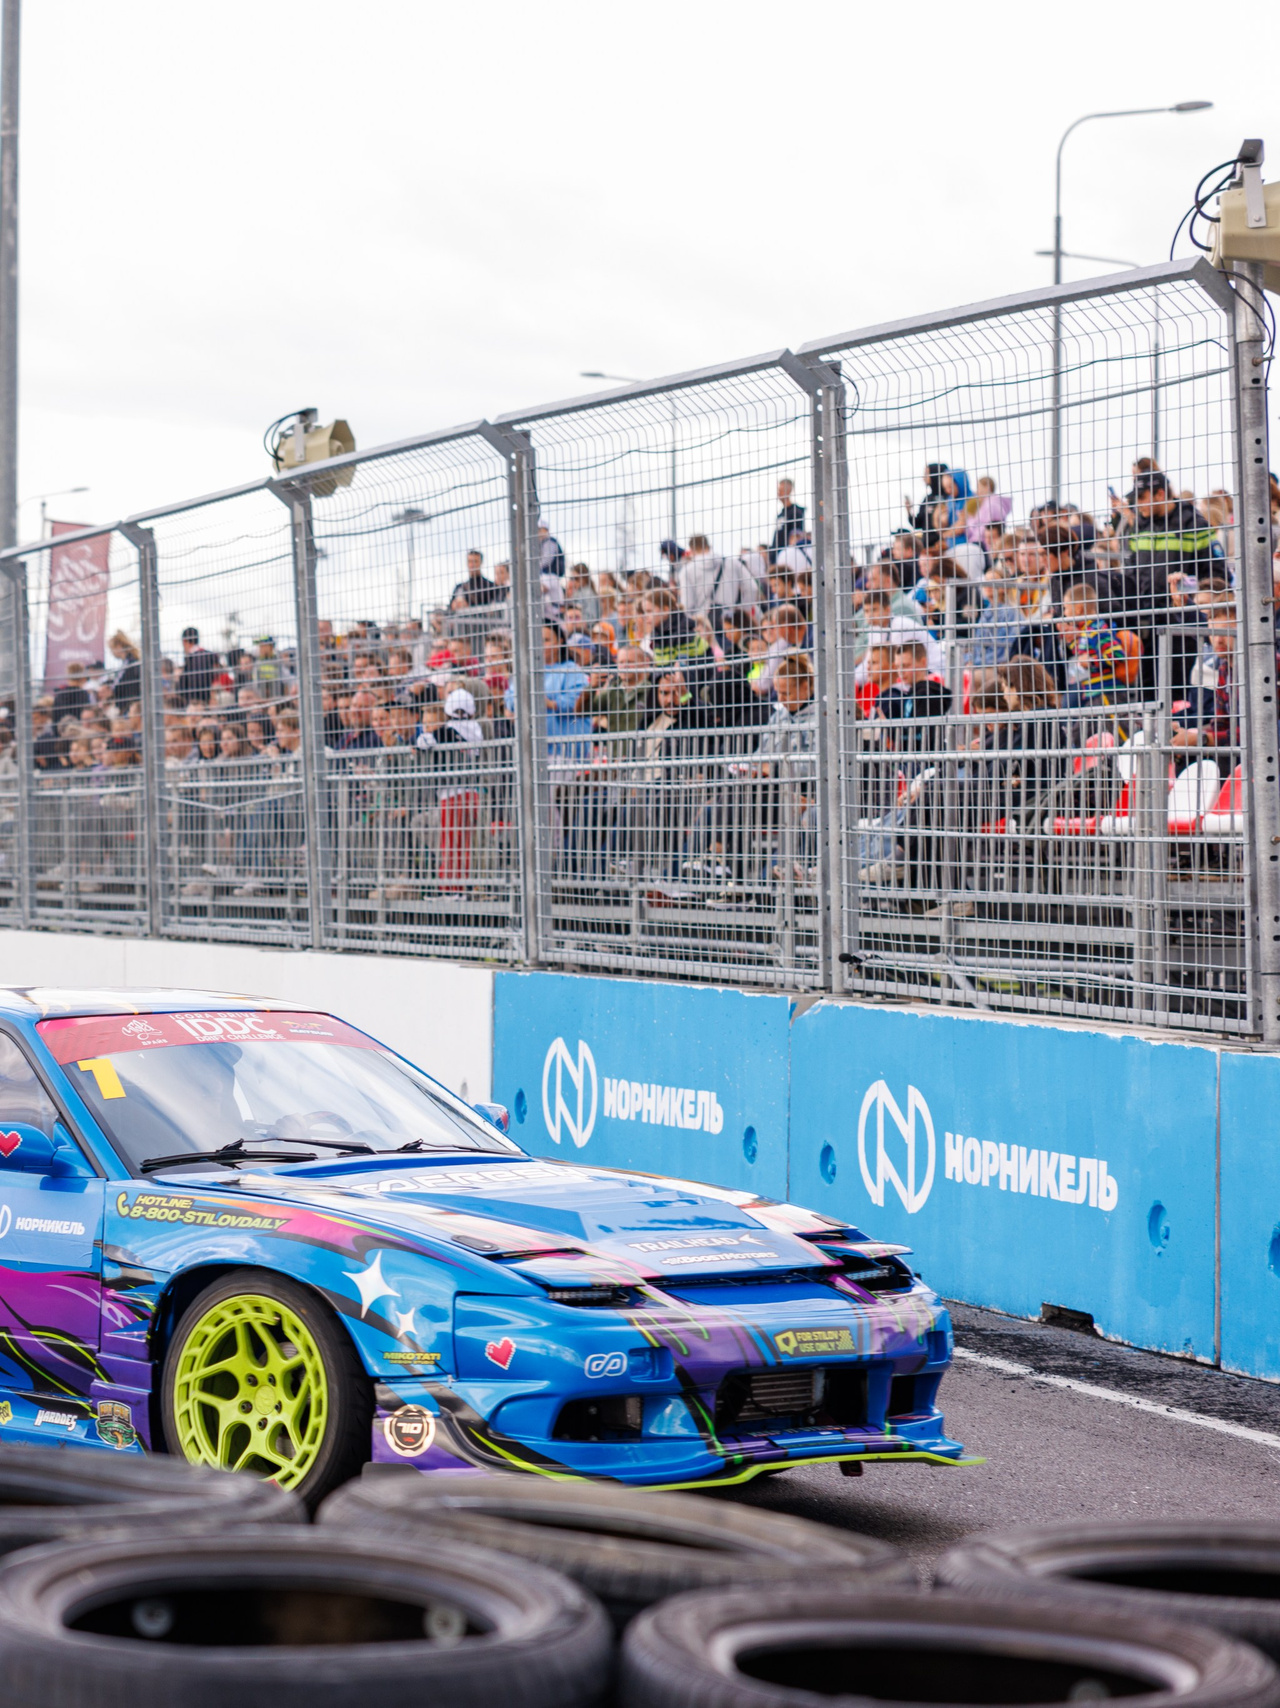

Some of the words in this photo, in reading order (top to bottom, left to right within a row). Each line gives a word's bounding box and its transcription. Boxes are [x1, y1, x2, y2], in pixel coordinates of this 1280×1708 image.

[170, 1012, 212, 1021] IGORA
[216, 1012, 259, 1020] DRIVE
[175, 1017, 278, 1037] IDDC
[195, 1034, 226, 1042] DRIFT
[227, 1033, 286, 1041] CHALLENGE
[76, 1058, 127, 1100] 1
[603, 1077, 724, 1135] НОРНИКЕЛЬ
[944, 1131, 1118, 1212] НОРНИКЕЛЬ
[136, 1194, 193, 1210] HOTLINE:
[15, 1216, 86, 1236] НОРНИКЕЛЬ
[129, 1206, 288, 1231] 8-800-STILOVDAILY
[626, 1236, 741, 1253] TRAILHEAD
